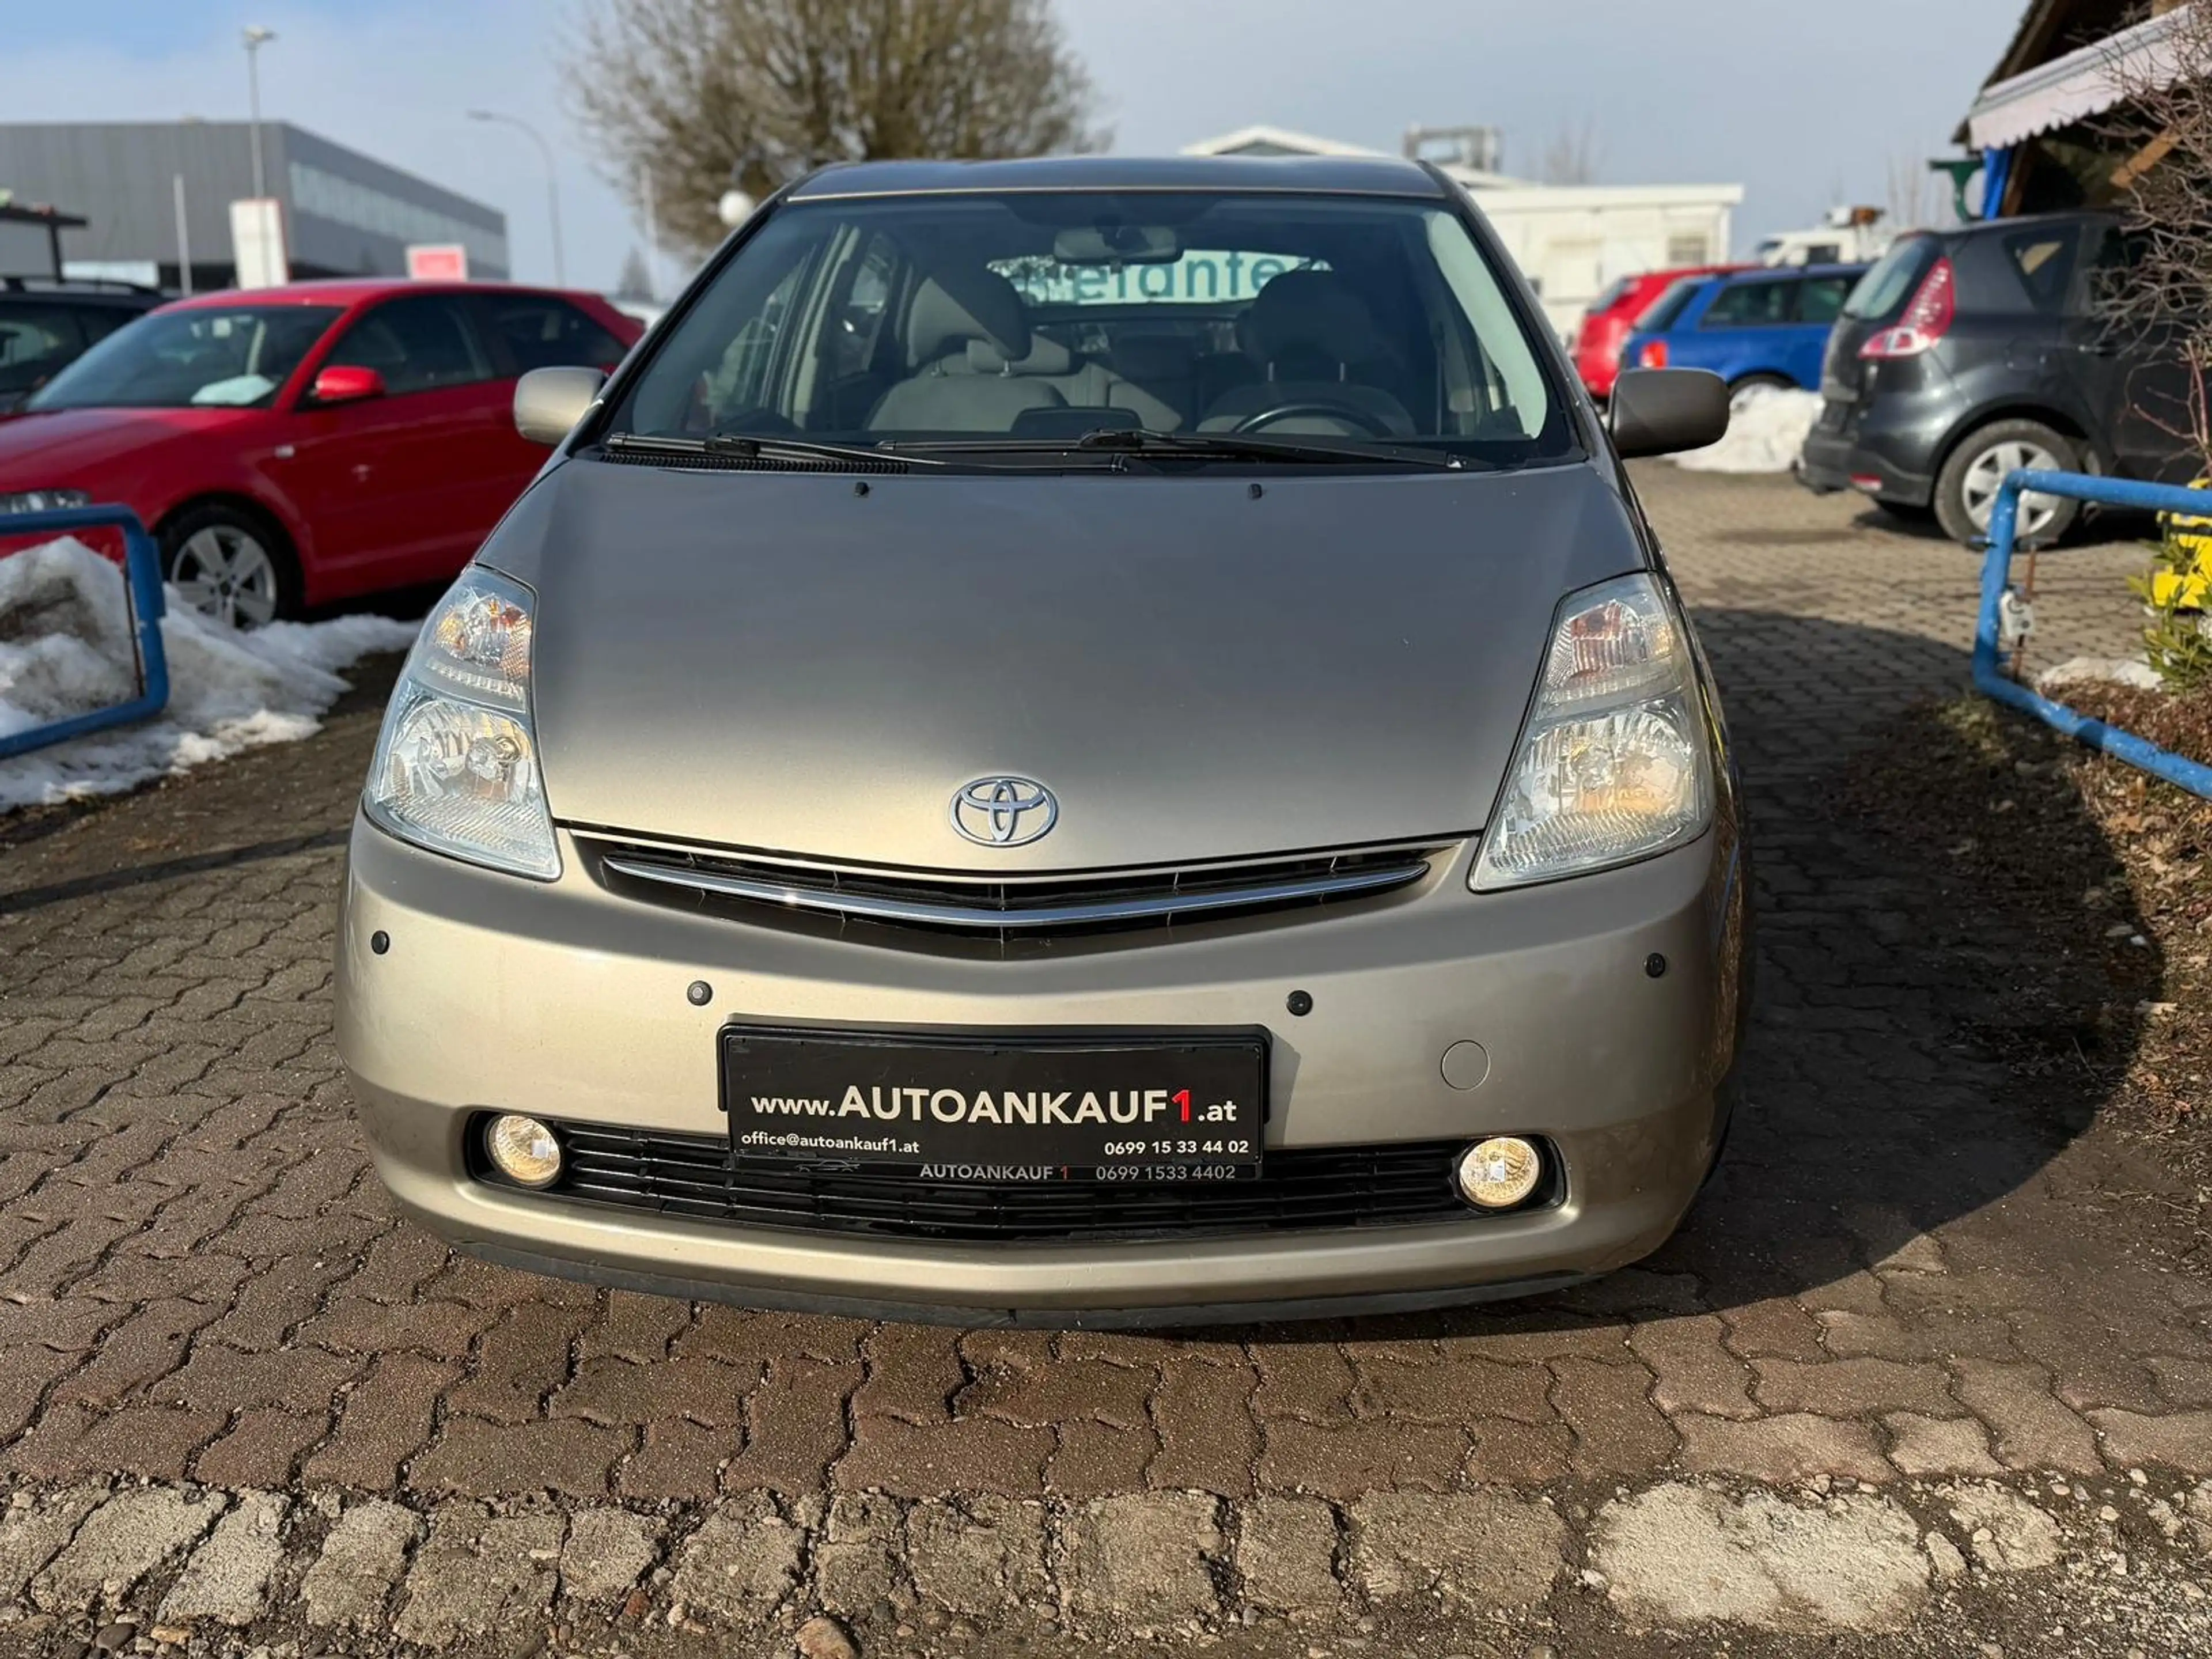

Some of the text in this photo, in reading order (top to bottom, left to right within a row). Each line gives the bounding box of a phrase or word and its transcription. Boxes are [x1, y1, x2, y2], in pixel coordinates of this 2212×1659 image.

[751, 1085, 1237, 1124] www.AUTOANKAUF1.at
[741, 1132, 920, 1153] office@autoankauf1.at
[1104, 1140, 1249, 1155] 0699 15 33 44 02
[920, 1164, 1236, 1180] AUTOANKAUF 1 0699 1533 4402
